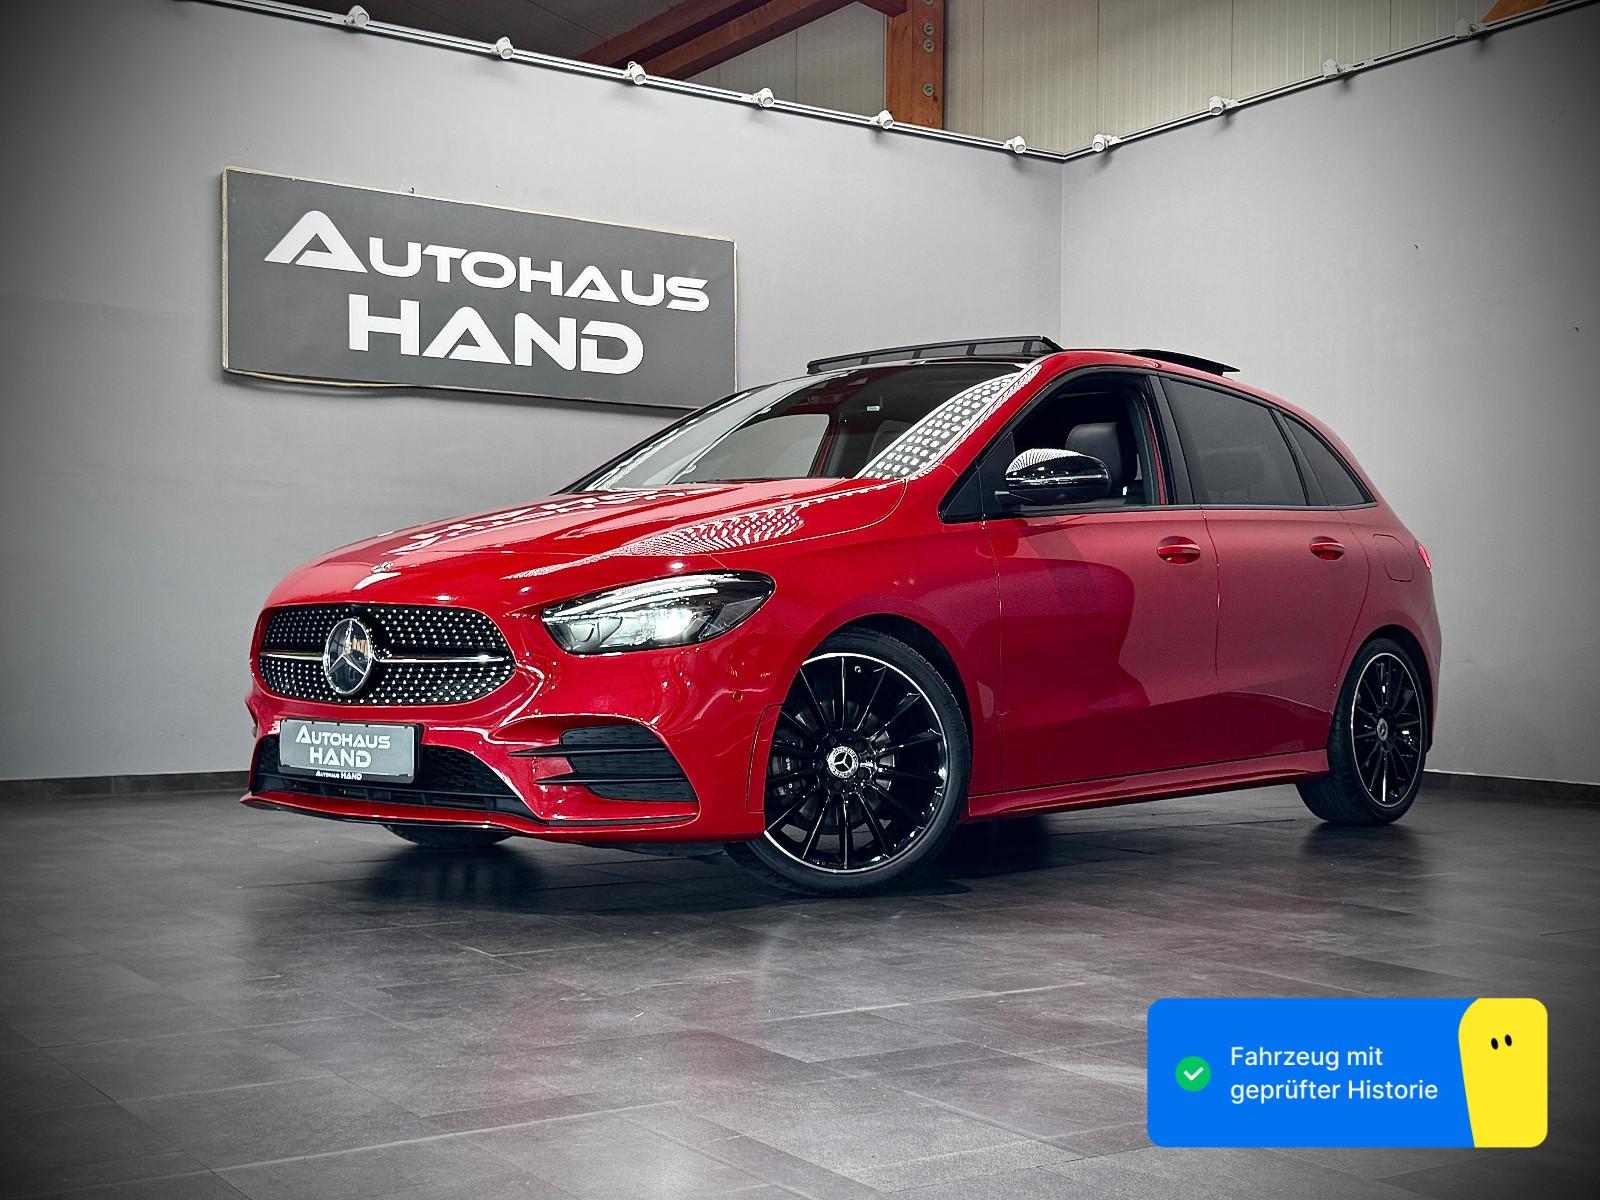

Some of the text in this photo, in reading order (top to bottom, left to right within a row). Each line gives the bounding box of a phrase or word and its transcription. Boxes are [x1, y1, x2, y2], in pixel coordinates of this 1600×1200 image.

[264, 209, 710, 313] AUTOHAUS
[348, 294, 644, 375] HAND
[295, 725, 391, 748] AUTOHAUS
[309, 747, 372, 768] HAND
[340, 771, 363, 780] HAND
